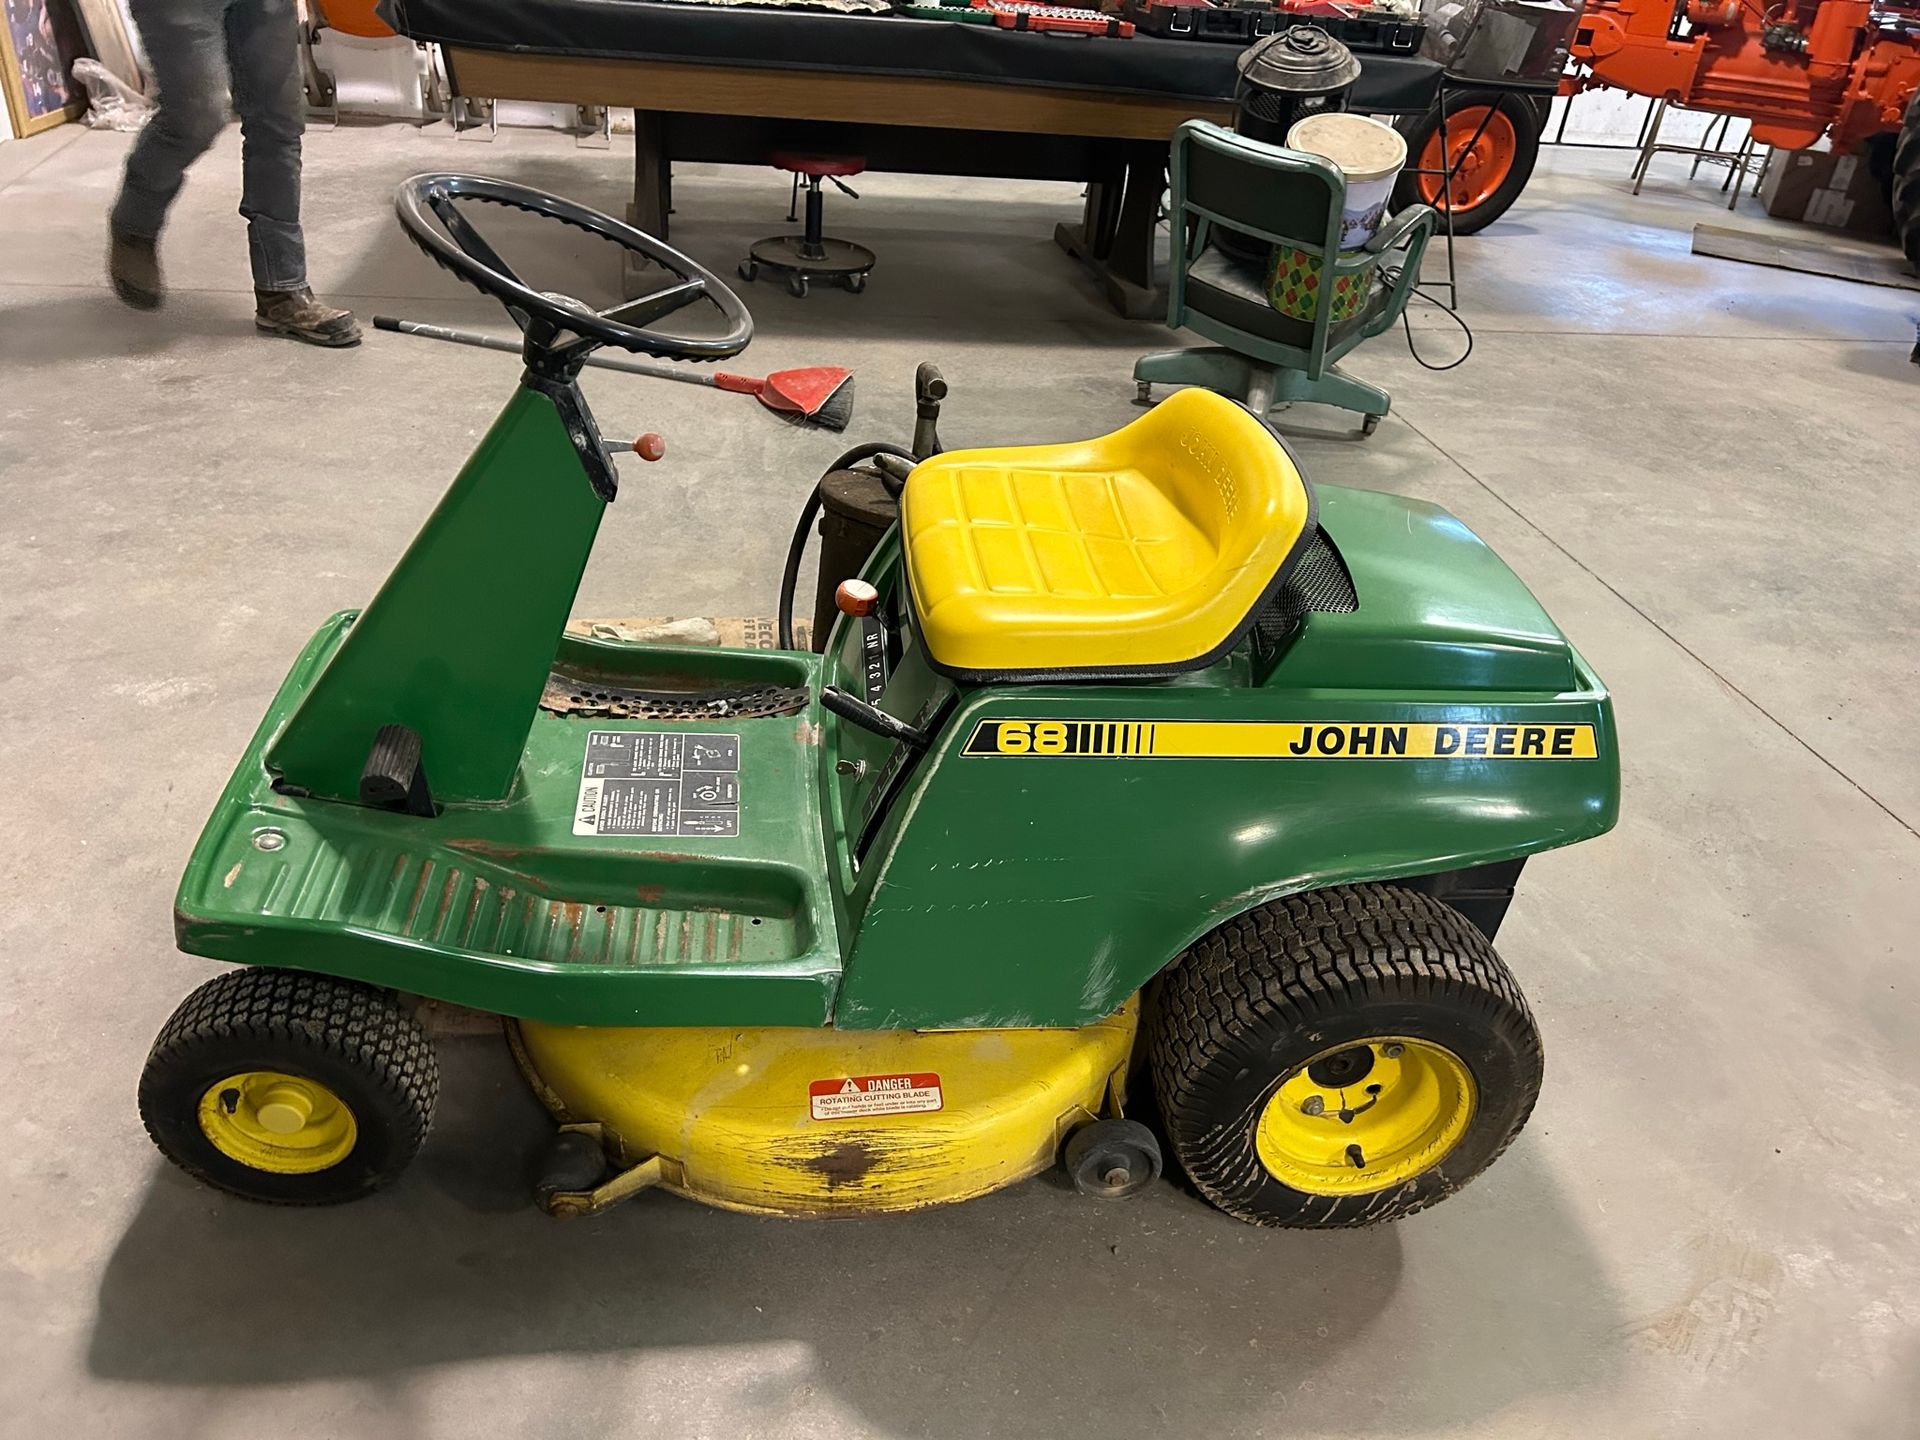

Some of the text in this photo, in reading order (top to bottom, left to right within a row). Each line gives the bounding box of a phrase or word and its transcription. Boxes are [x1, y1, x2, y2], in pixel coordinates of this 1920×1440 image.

[997, 722, 1068, 753] 68
[1290, 726, 1576, 755] JOHN DEERE
[582, 786, 599, 813] CAUTION
[868, 1078, 911, 1091] DANGER
[820, 1096, 862, 1105] ROTATING
[864, 1093, 901, 1101] CUTTING
